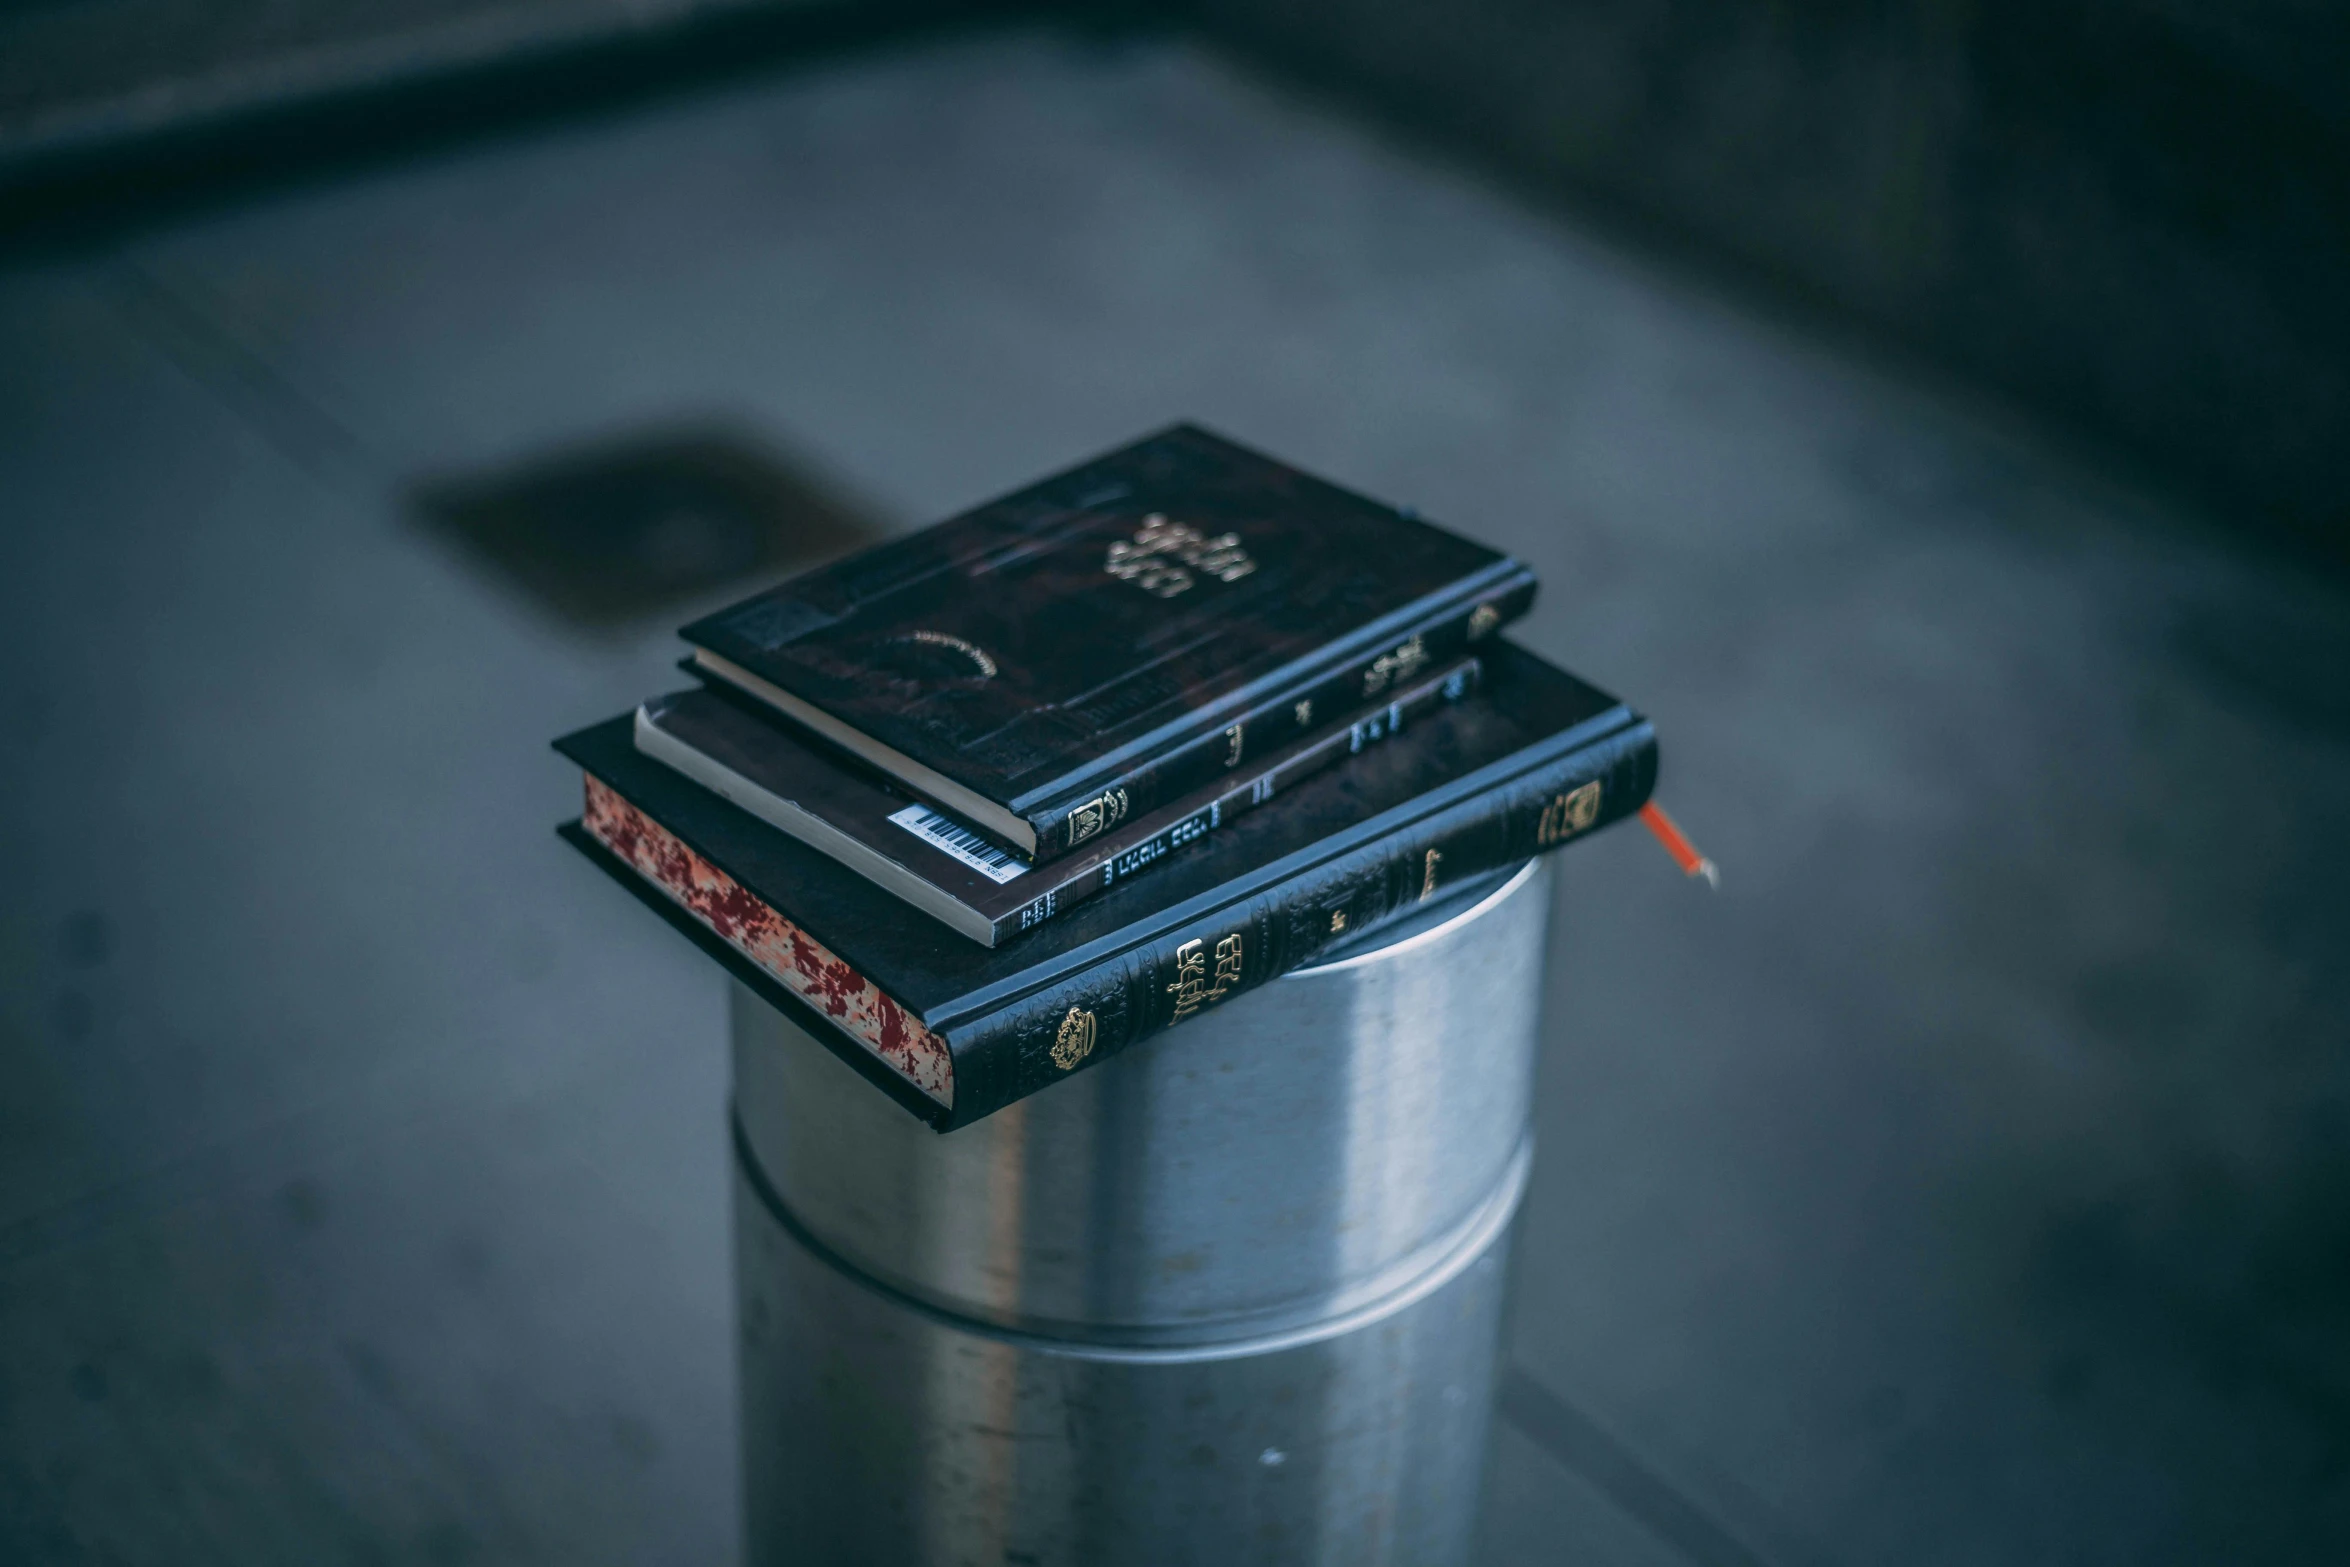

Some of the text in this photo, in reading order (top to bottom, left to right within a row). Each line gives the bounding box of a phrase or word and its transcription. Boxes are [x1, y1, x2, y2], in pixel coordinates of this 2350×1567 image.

[985, 866, 1010, 881] ISBN
[1118, 817, 1208, 876] תלמוד בבלי
[1166, 938, 1206, 1027] תלמוד
[1201, 933, 1243, 1001] בבלי
